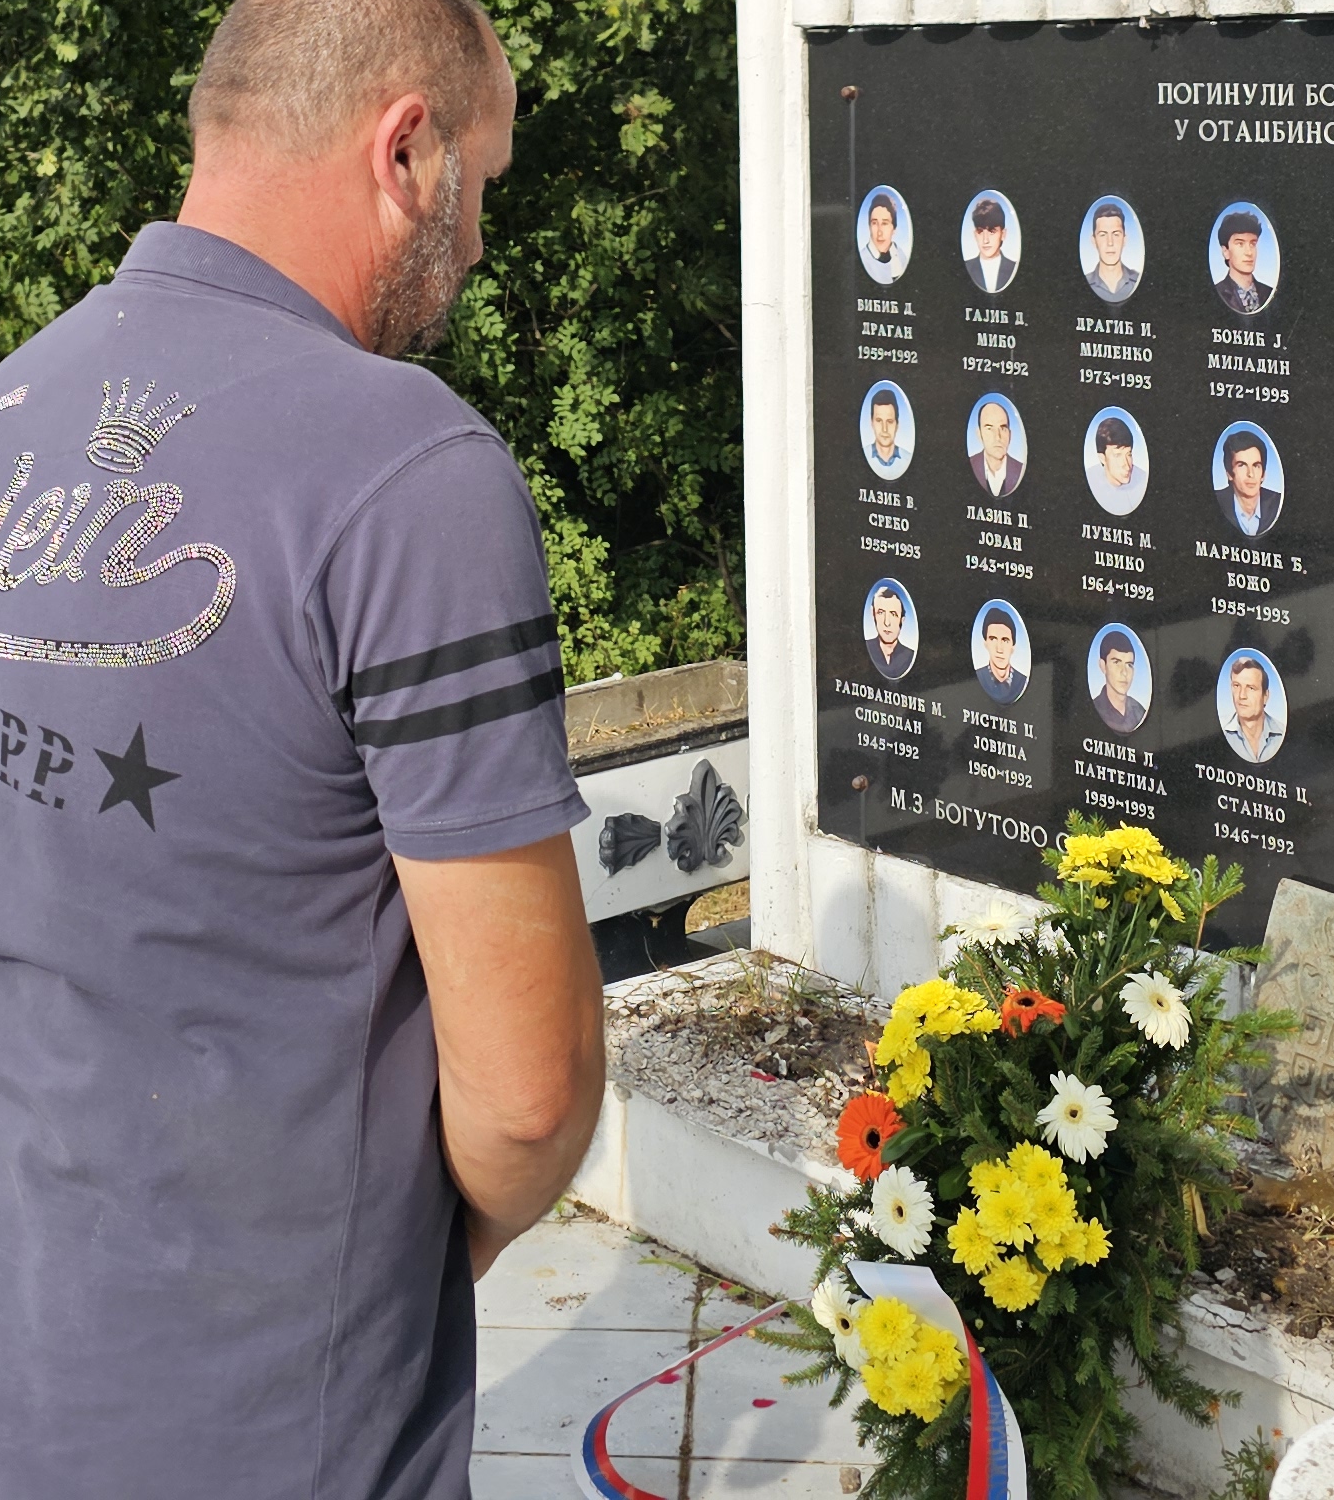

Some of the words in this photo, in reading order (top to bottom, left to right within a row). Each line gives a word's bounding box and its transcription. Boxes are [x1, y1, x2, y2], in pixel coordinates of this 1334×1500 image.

[1158, 82, 1294, 107] ПОГИНУЛИ
[1175, 120, 1188, 141] У
[862, 322, 912, 339] ДРАГАН
[1141, 322, 1156, 339] И.
[1080, 342, 1153, 363] МИЛЕНКО
[1208, 354, 1290, 376] МИЛАДИН
[978, 531, 1023, 552] ЈОВАН
[1139, 532, 1156, 550] М.
[1095, 551, 1145, 573] ЦВИКО
[1195, 541, 1283, 570] МАРКОВИЋ
[1227, 572, 1270, 593] БОЖО
[835, 679, 926, 713] РАДОВАНОВИЋ
[931, 701, 946, 718] М.
[855, 707, 922, 735] СЛОБОДАН
[974, 735, 1027, 761] ЈОВИЦА
[1075, 760, 1167, 796] ПАНТЕЛИЈА
[1195, 763, 1288, 798] ТОДОРОВИЋ
[1217, 795, 1286, 824] СТАНКО
[935, 799, 1047, 848] БОГУТОВО
